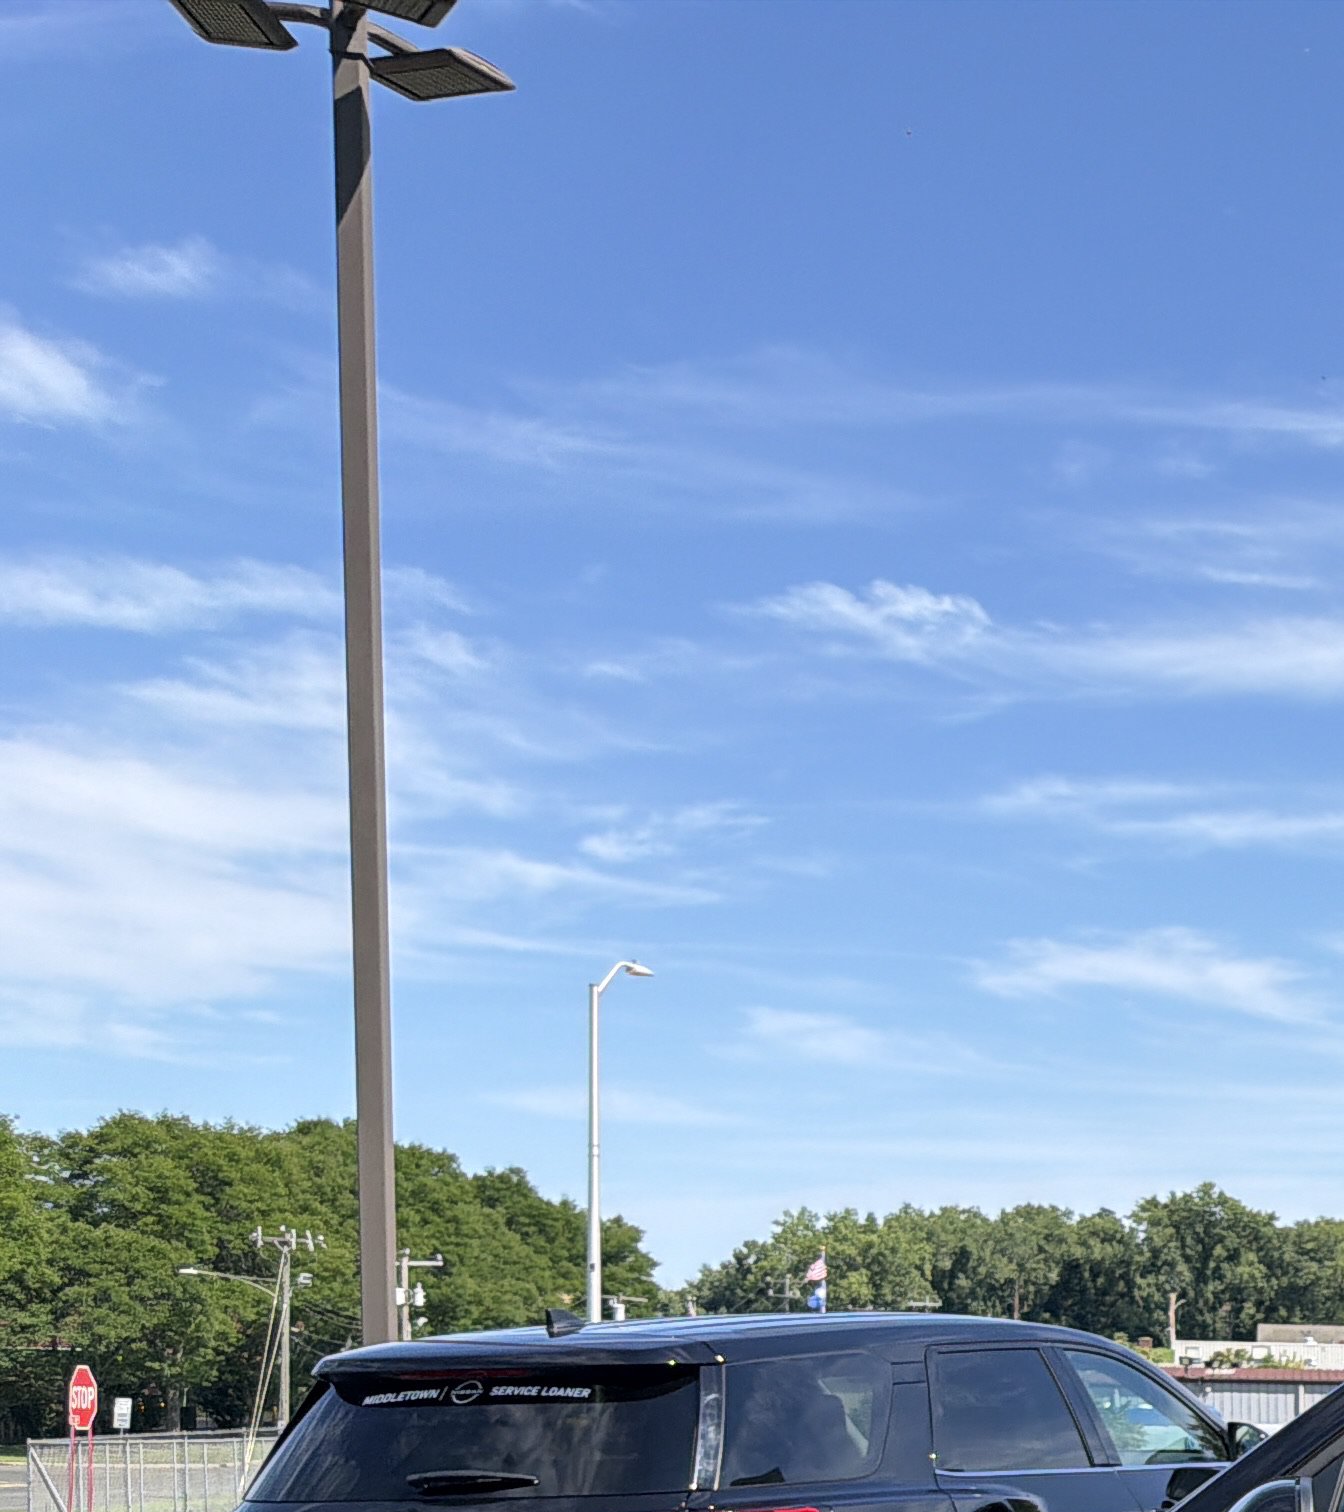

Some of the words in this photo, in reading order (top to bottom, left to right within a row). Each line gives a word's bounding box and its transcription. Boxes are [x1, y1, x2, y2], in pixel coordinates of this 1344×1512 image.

[71, 1386, 95, 1410] STOP
[361, 1388, 441, 1406] MIDDLETOWN
[489, 1386, 540, 1397] SERVICE
[541, 1386, 592, 1398] LOANER
